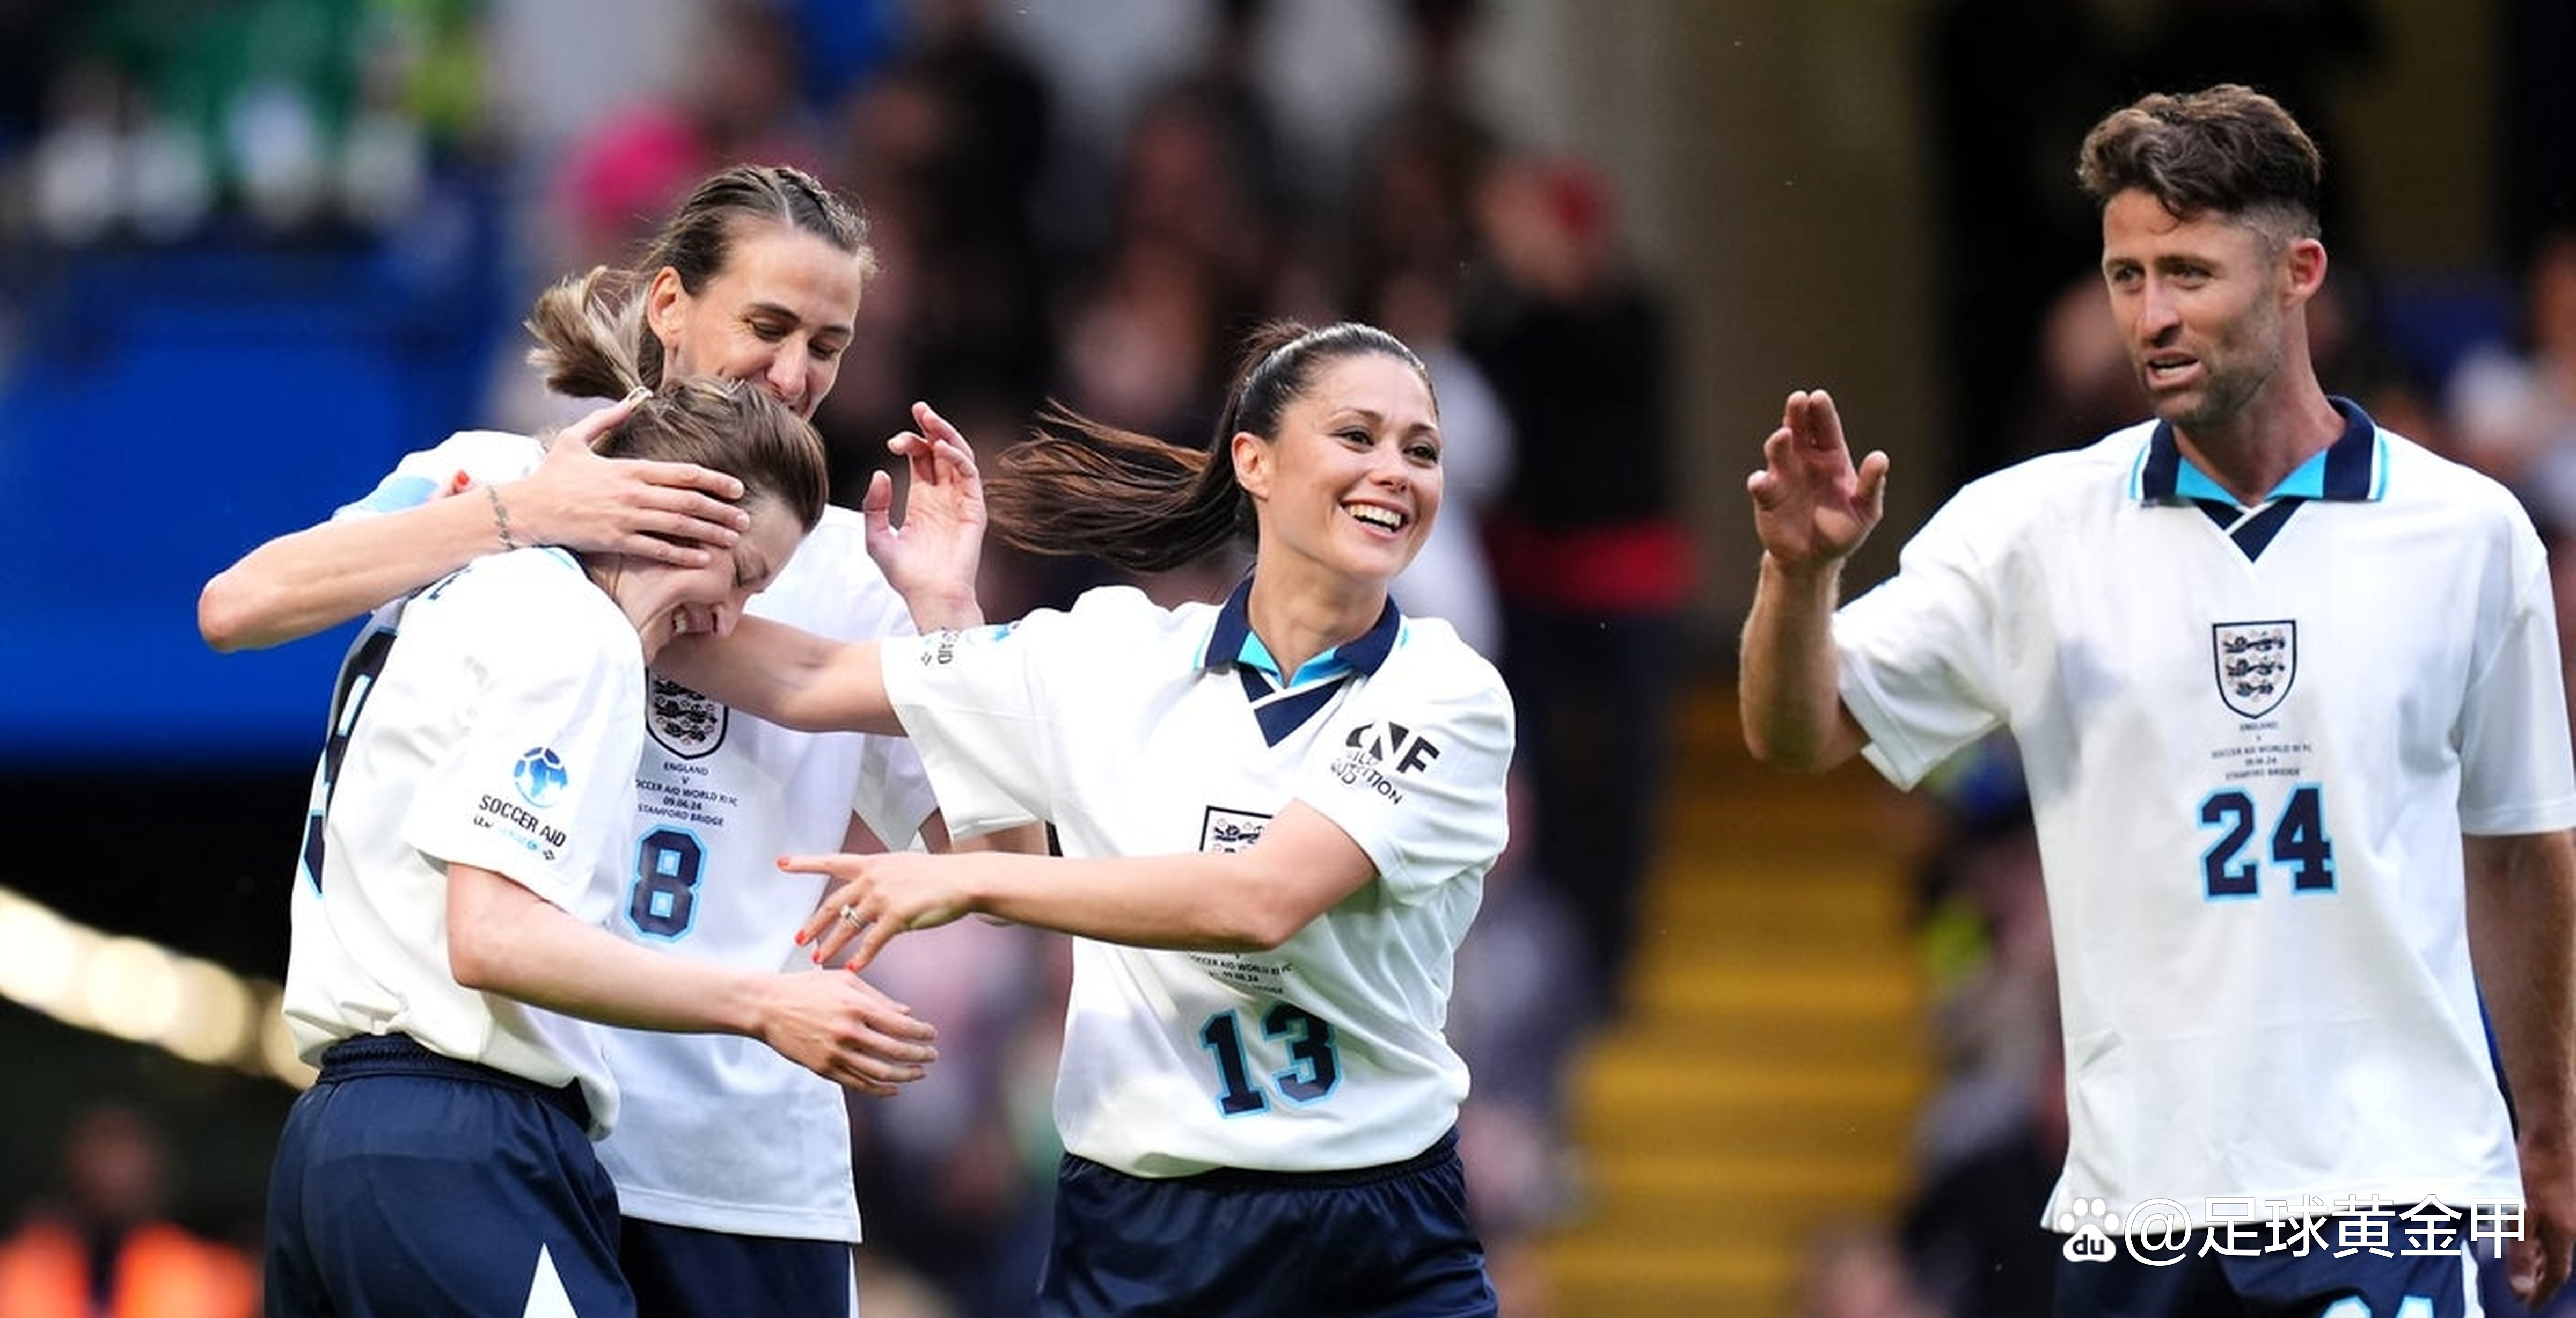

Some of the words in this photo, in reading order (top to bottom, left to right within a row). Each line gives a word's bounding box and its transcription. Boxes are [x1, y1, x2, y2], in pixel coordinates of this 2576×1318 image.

[663, 762, 709, 776] ENGLAND
[664, 784, 680, 796] AID
[683, 788, 718, 802] WORLD
[478, 793, 539, 833] SOCCER
[539, 824, 567, 848] AID
[638, 803, 690, 820] STAMFORD
[690, 813, 725, 826] BRIDGE
[2197, 780, 2340, 902] 24
[624, 823, 708, 943] 8
[1199, 1001, 1343, 1119] 13
